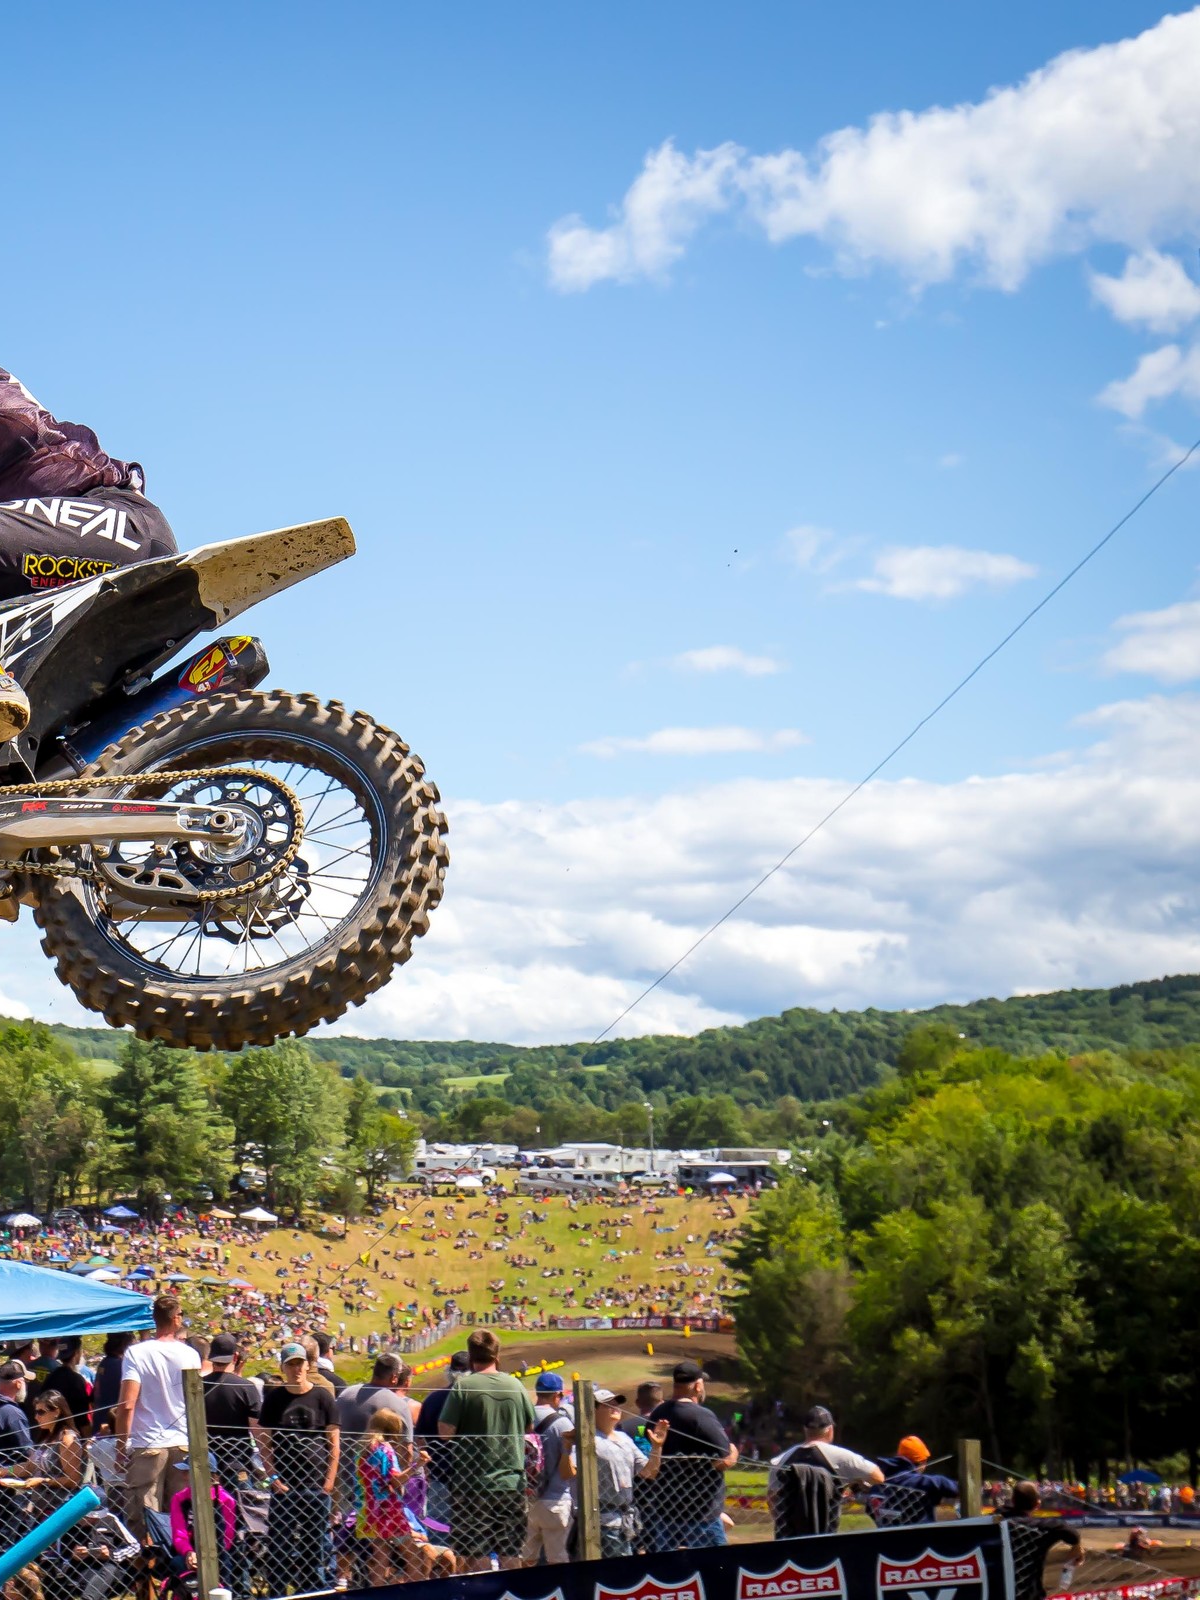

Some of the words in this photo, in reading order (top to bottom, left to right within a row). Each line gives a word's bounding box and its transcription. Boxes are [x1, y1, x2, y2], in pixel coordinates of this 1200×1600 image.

[617, 1318, 646, 1328] LUCAS
[648, 1318, 663, 1327] OIL
[884, 1564, 974, 1584] RACER
[745, 1576, 835, 1597] RACER
